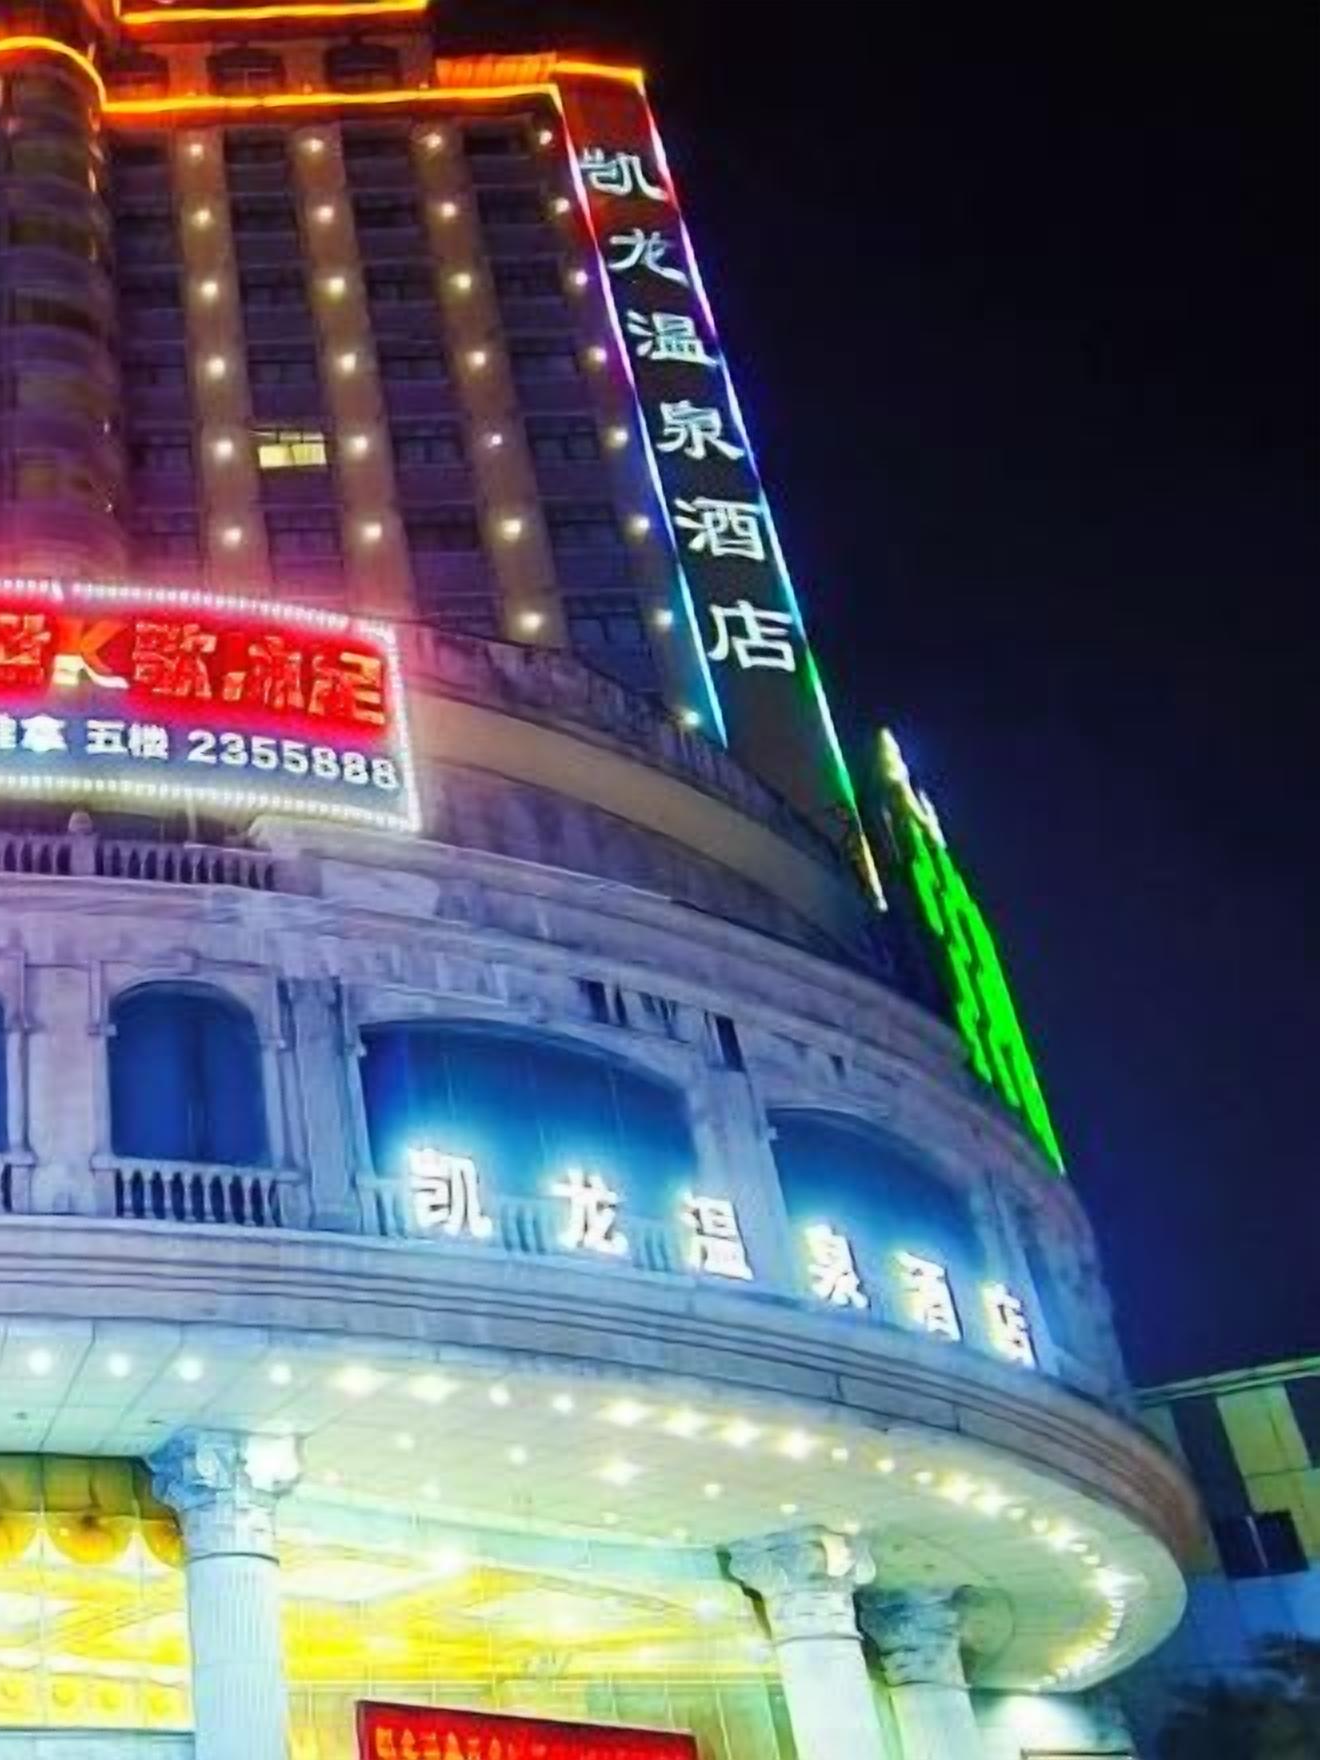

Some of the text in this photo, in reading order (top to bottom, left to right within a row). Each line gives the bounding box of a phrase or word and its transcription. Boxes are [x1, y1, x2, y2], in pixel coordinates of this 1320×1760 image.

[579, 146, 796, 673] 凯龙温泉酒店
[187, 730, 398, 789] 2355888
[408, 1148, 1035, 1368] 凯龙温泉酒店
